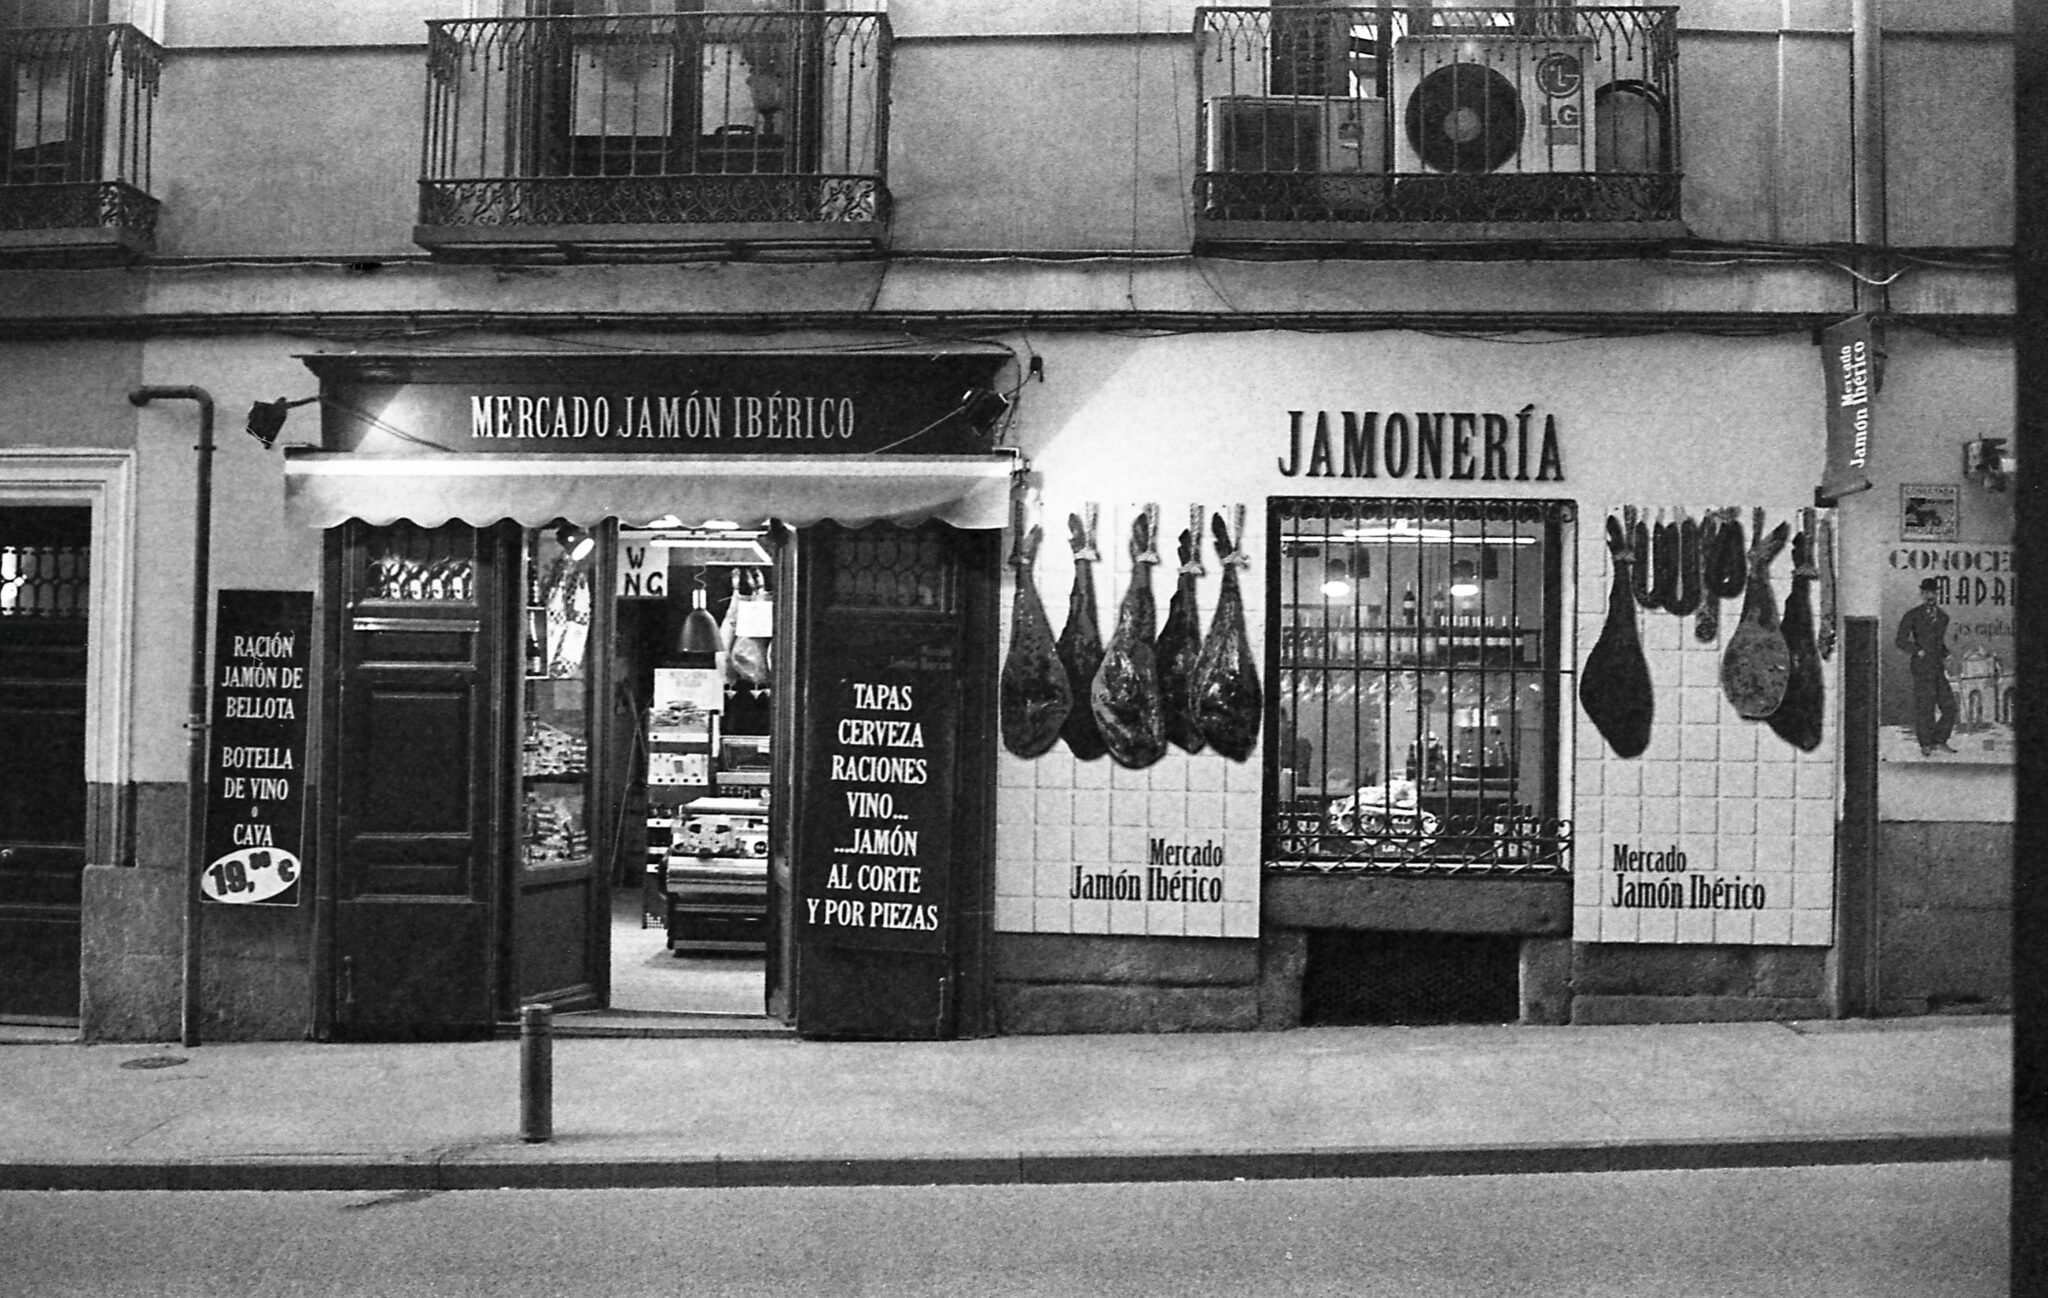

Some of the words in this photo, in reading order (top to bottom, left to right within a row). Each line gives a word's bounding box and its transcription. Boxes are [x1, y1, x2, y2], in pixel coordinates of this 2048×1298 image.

[1841, 345, 1853, 406] Mercado
[1852, 341, 1868, 406] Ibérico
[471, 396, 609, 438] MERCADO
[617, 390, 721, 438] JAMÓN
[733, 391, 854, 438] IBÉRICO
[1278, 404, 1565, 481] JAMONERÍA
[1850, 408, 1868, 468] Jamón
[234, 632, 294, 658] RACIÓN
[221, 662, 277, 688] JAMÓN
[281, 667, 303, 689] DE
[226, 697, 295, 719] BELLOTA
[853, 683, 912, 711] TAPAS
[838, 718, 924, 748] CERVEZA
[222, 747, 293, 770] BOTELLA
[831, 754, 927, 784] RACIONES
[224, 777, 245, 798] DE
[251, 778, 288, 800] VINO
[846, 791, 908, 820] VINO...
[233, 824, 273, 846] CAVA
[834, 825, 918, 856] ...JAMÓN
[1150, 838, 1223, 867] Mercado
[1613, 844, 1687, 873] Mercado
[827, 863, 852, 890] AL
[857, 865, 921, 893] CORTE
[1070, 865, 1141, 901] Jamón
[1146, 867, 1222, 902] Ibérico
[1611, 873, 1684, 909] Jamón
[1689, 874, 1766, 910] Ibérico
[807, 898, 820, 924] Y
[824, 899, 865, 927] POR
[870, 902, 938, 931] PIEZAS
